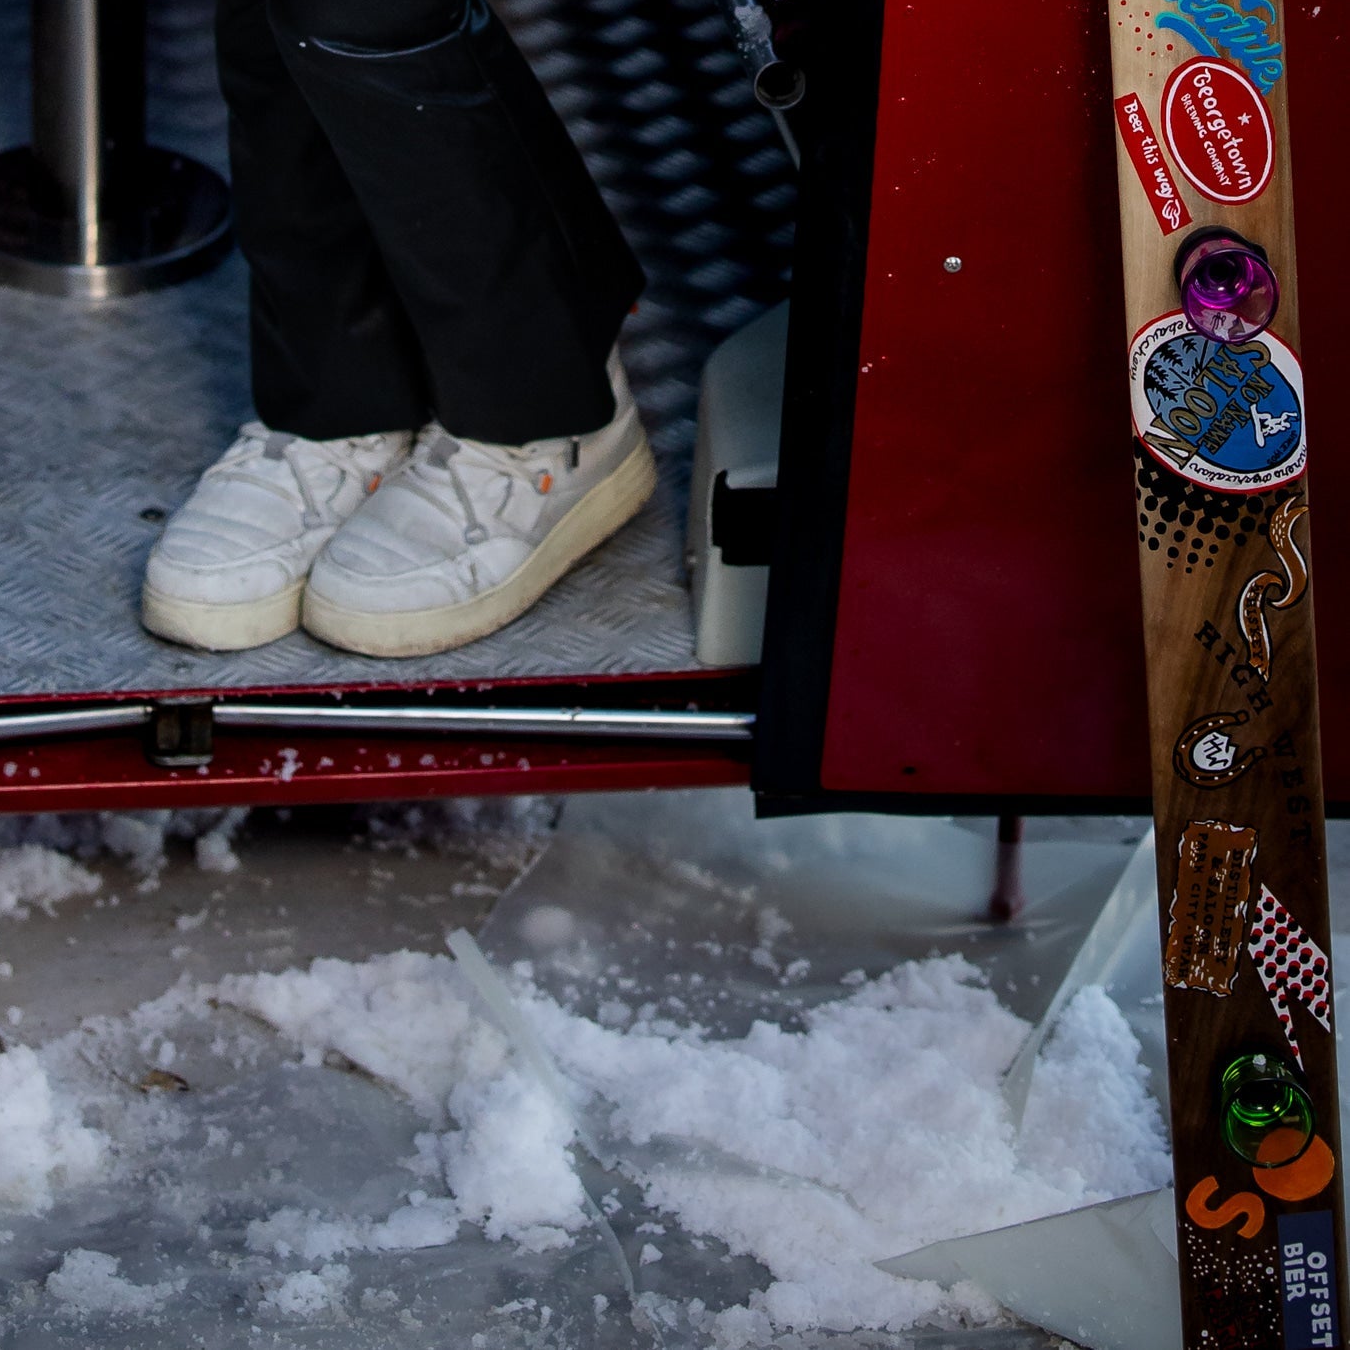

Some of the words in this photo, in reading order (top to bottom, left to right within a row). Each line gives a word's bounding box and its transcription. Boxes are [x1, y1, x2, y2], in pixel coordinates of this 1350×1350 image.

[1124, 99, 1145, 134] Beer
[1141, 136, 1159, 165] this
[1154, 167, 1174, 200] way
[1180, 93, 1205, 137] BREWING
[1203, 140, 1231, 187] COMPANY
[1192, 68, 1252, 190] Georgetown
[1145, 339, 1272, 469] SALOON
[1199, 399, 1251, 455] NAME
[1243, 369, 1275, 405] NO
[1194, 620, 1273, 716] HIGH
[1272, 729, 1312, 847] WEST
[1186, 882, 1200, 922] CITY
[1200, 877, 1218, 955] SALOON
[1216, 848, 1242, 967] DISTILLERY
[1178, 932, 1194, 980] UTAH
[1284, 1243, 1306, 1302] BIER
[1307, 1251, 1333, 1349] OFFSET
